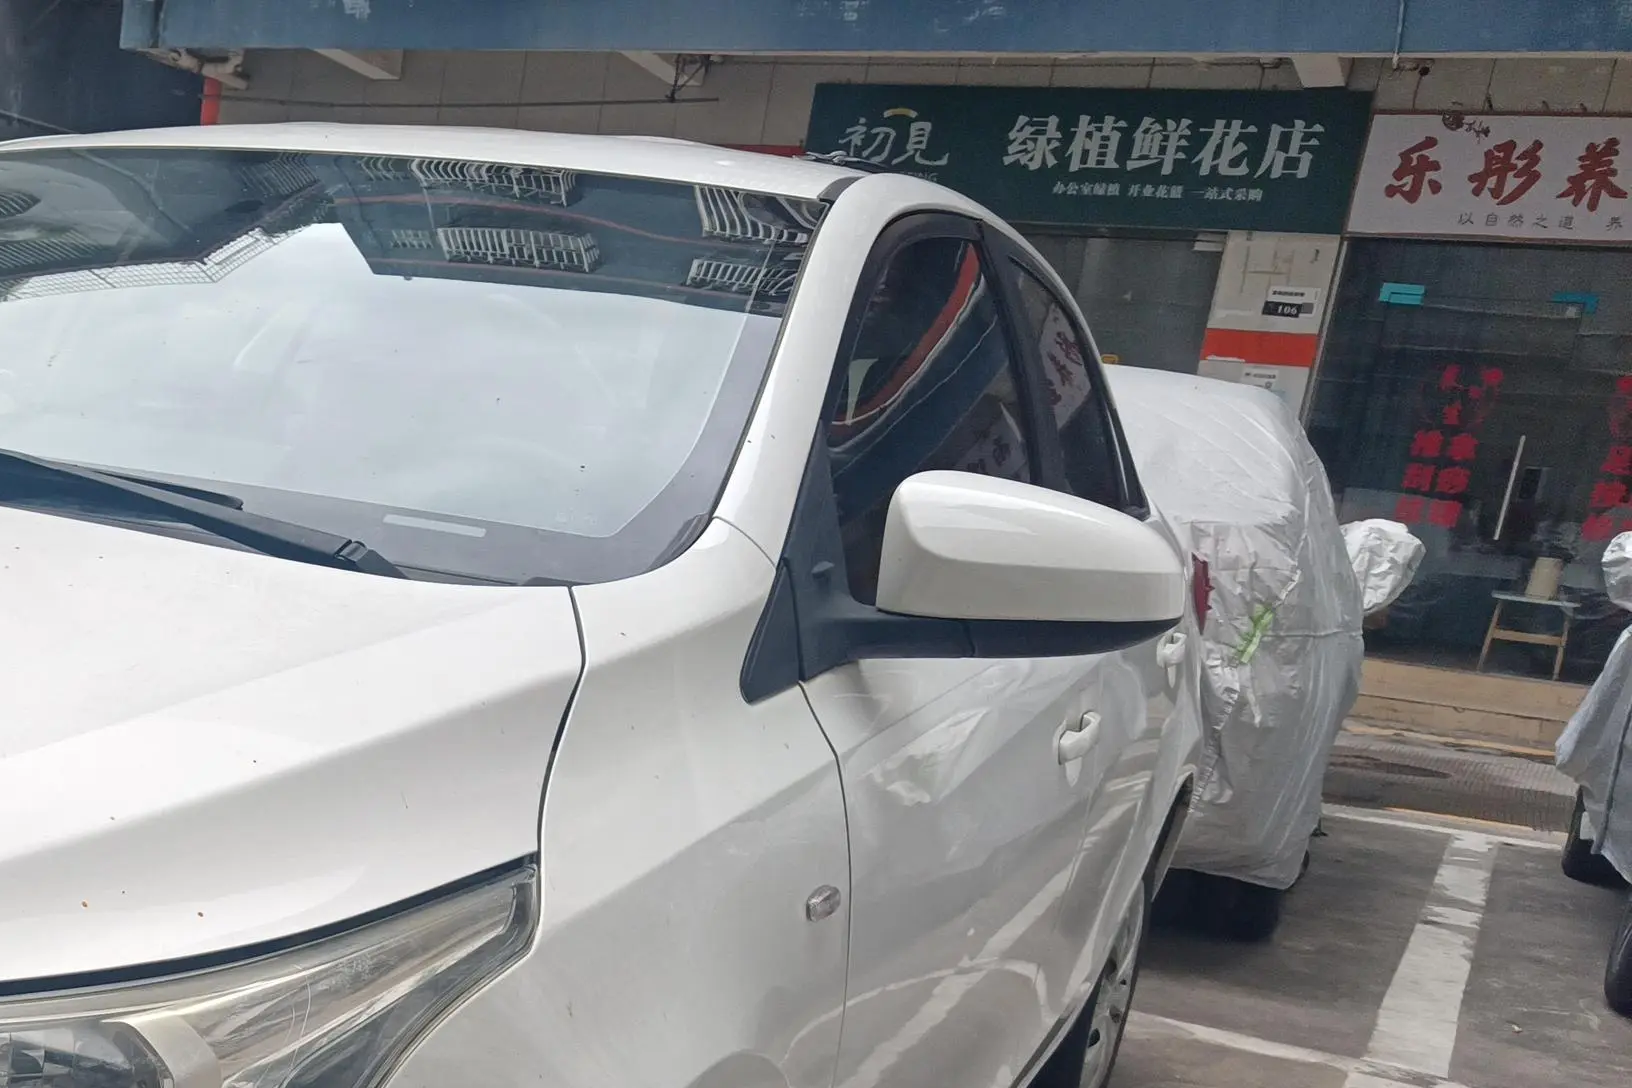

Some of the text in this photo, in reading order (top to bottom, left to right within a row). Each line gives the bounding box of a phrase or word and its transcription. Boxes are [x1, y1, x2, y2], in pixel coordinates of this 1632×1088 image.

[1002, 114, 1325, 180] 绿植鲜花店
[1384, 136, 1628, 212] 乐彤养
[1277, 304, 1298, 315] 106
